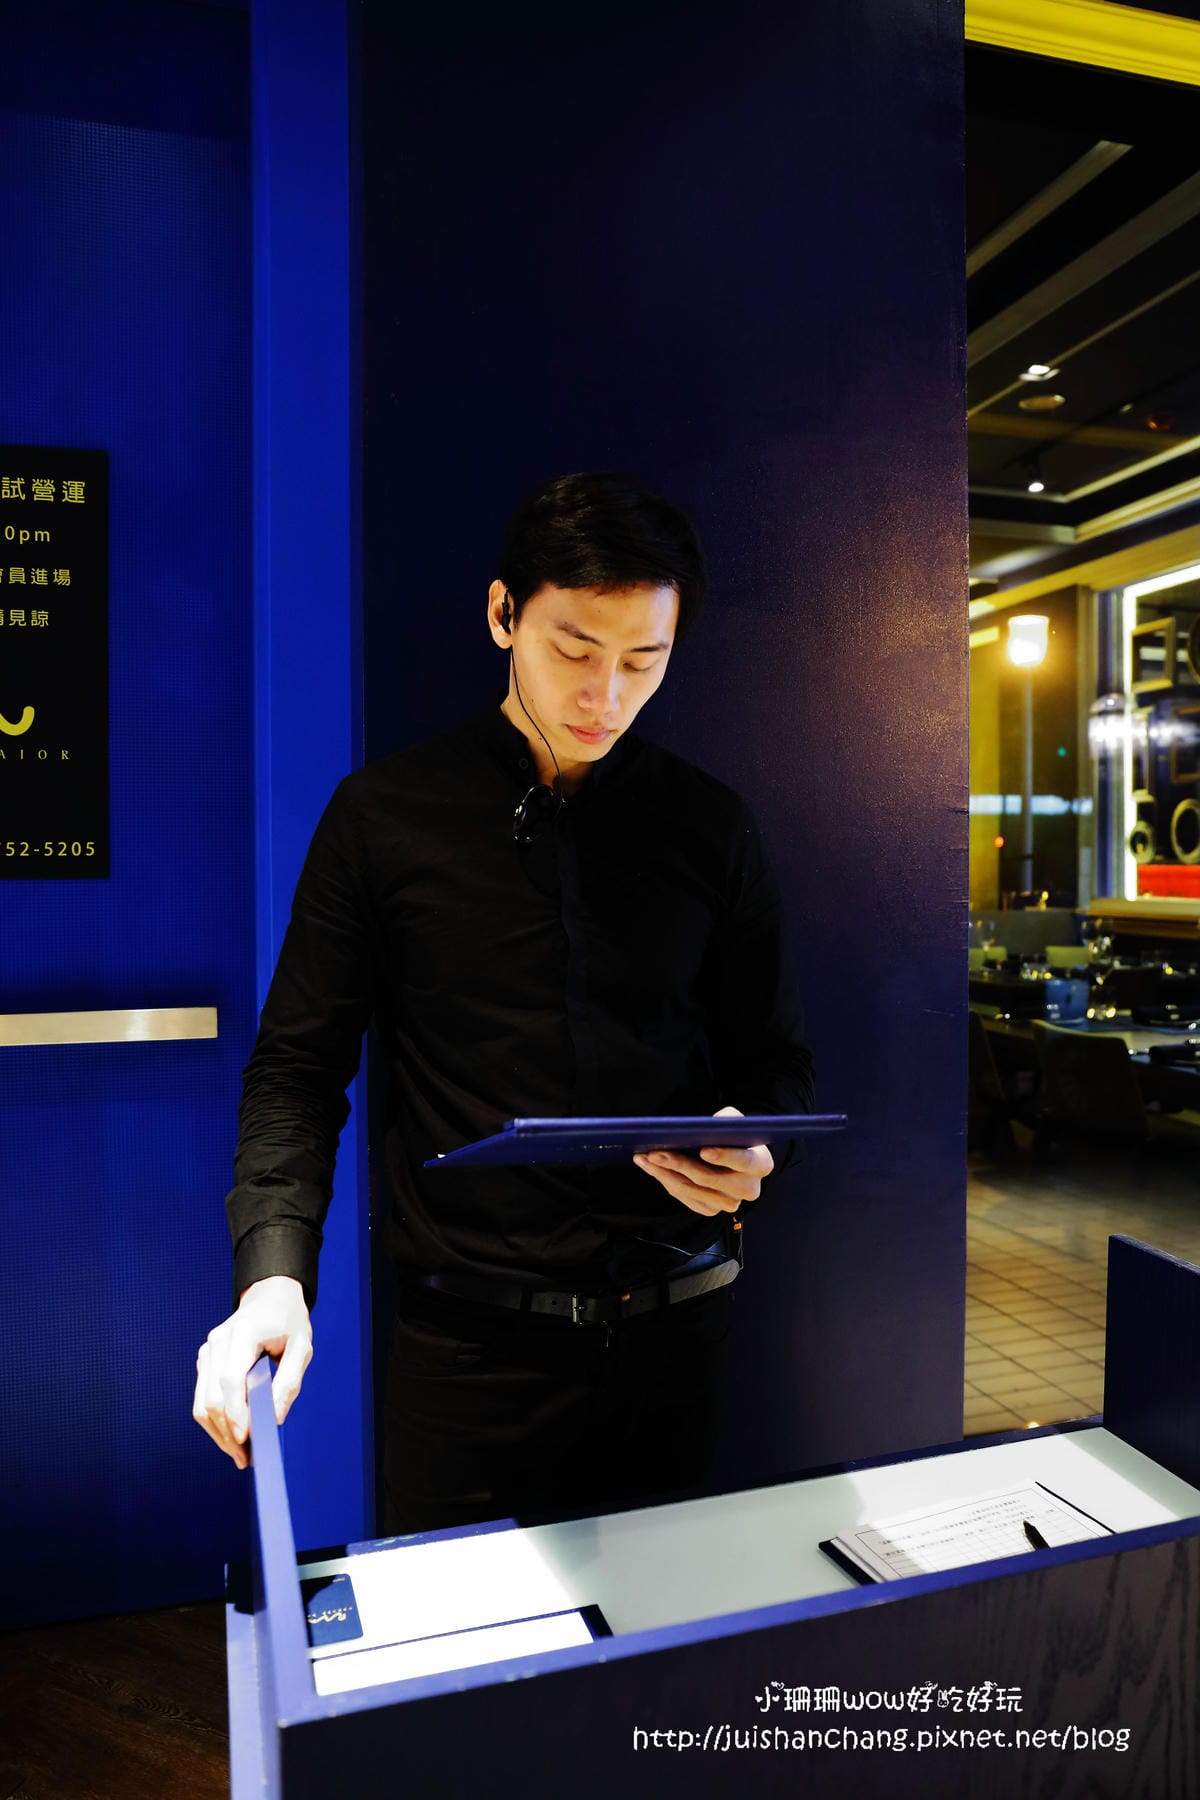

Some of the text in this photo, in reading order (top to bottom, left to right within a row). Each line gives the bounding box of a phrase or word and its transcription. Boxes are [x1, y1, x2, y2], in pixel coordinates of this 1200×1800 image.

[1, 476, 86, 504] 試營運
[4, 525, 51, 545] 0pm
[0, 567, 71, 587] 員進場
[0, 609, 49, 628] 見諒
[0, 841, 95, 857] 52-5205
